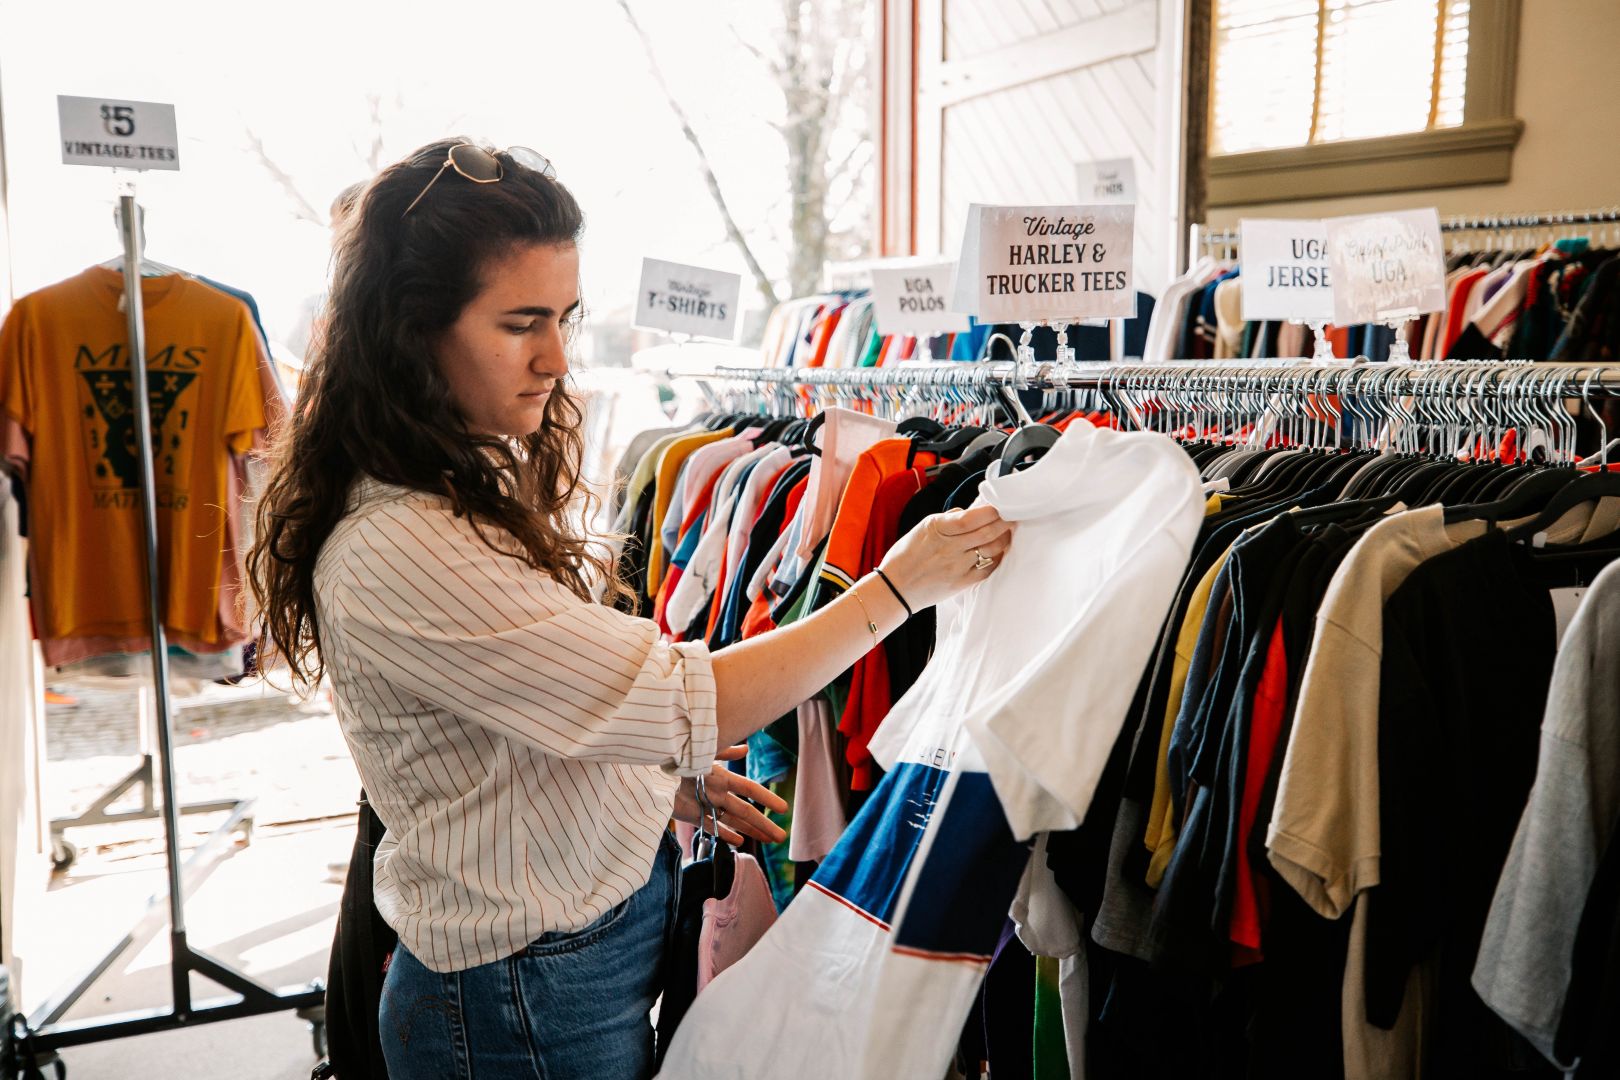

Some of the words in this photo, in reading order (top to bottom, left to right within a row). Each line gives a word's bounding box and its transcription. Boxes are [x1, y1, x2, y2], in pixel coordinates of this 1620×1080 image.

[64, 140, 134, 159] VINTAGE
[138, 146, 176, 161] TEES
[1024, 216, 1096, 241] Vintage
[1009, 243, 1087, 266] HARLEY
[1092, 242, 1107, 264] &
[987, 272, 1076, 296] TRUCKER
[1081, 271, 1127, 292] TEES
[1267, 265, 1332, 287] JERSE
[1372, 259, 1408, 284] UGA
[904, 277, 934, 293] UGA
[648, 290, 728, 321] T-SHIRTS
[898, 296, 945, 312] POLOS
